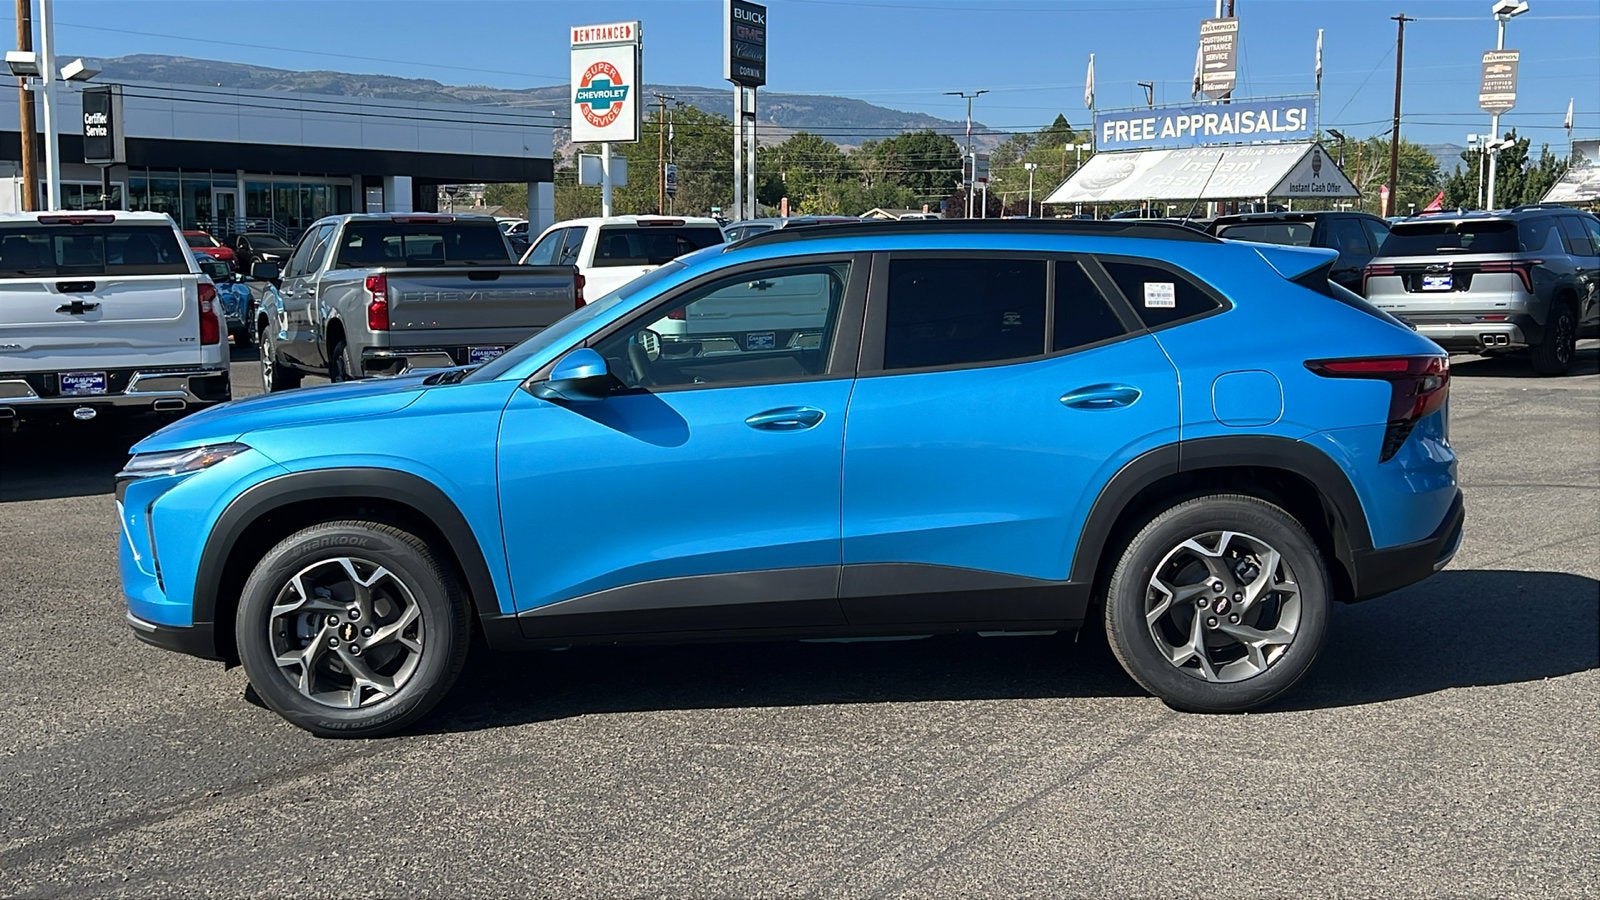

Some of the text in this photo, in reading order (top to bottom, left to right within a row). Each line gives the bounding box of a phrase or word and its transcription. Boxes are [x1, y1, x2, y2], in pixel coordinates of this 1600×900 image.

[734, 8, 765, 25] BUICK
[736, 25, 764, 42] GMC
[1202, 24, 1237, 32] CHAMPION
[579, 26, 625, 42] ENTRANCE
[1203, 35, 1233, 44] CUSTOMER
[1203, 43, 1233, 52] ENTRANCE
[1205, 53, 1229, 62] SERVICE
[585, 63, 617, 80] SUPER
[577, 89, 625, 100] CHEVROLET
[84, 112, 107, 124] Certified
[583, 105, 621, 126] SERVICE
[86, 125, 107, 137] Service
[1103, 107, 1307, 144] FREE APPRAISALS!
[1238, 147, 1266, 156] Blue
[1266, 146, 1300, 155] Book
[1289, 182, 1342, 193] Instant Cash Offer
[62, 376, 103, 384] CHAMPION
